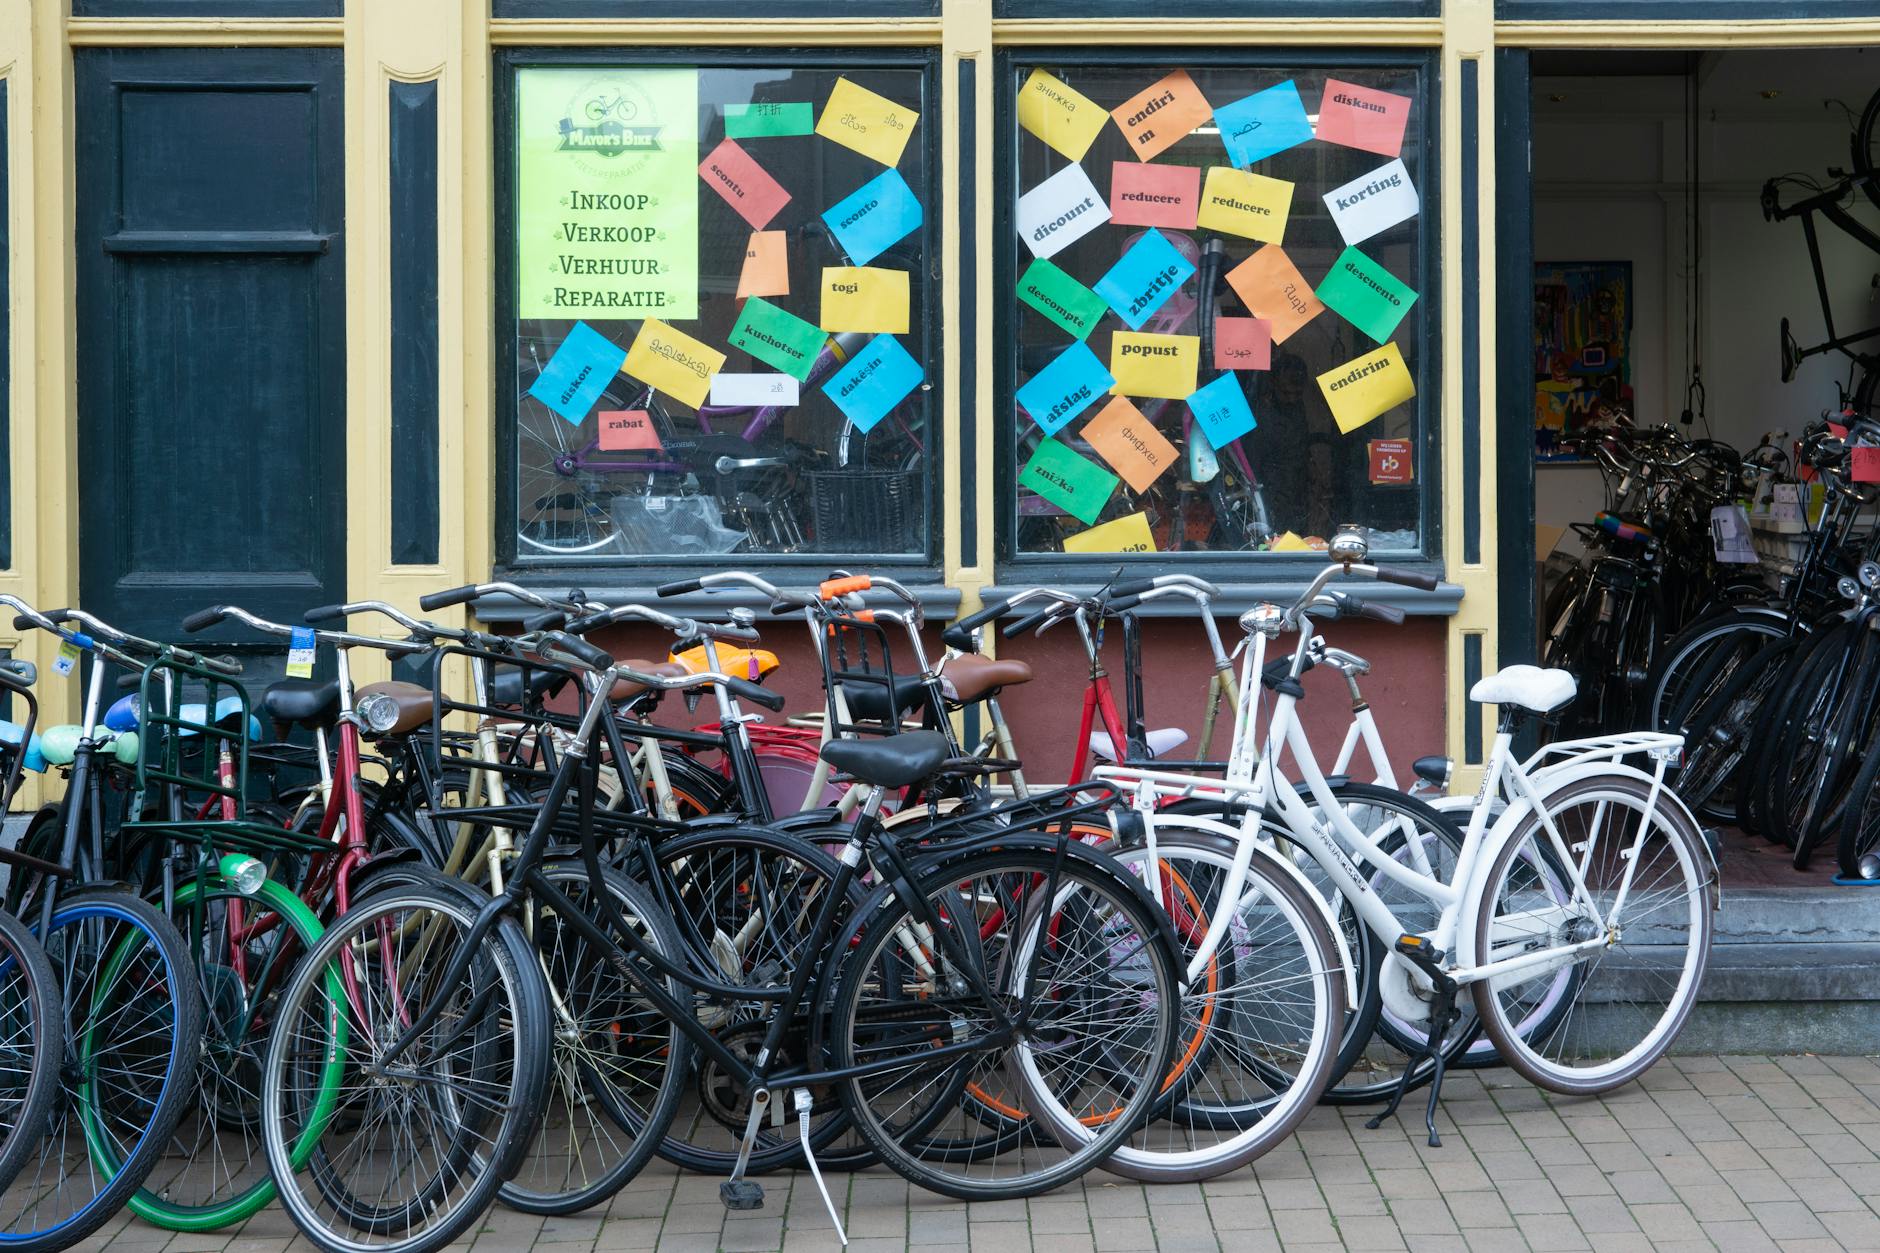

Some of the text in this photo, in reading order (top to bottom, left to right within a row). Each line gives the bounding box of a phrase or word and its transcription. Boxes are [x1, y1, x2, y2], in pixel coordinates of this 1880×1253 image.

[757, 104, 781, 116] 打折
[1035, 82, 1076, 112] знижка
[1126, 90, 1177, 128] endiri
[1333, 93, 1387, 115] diskaun
[1138, 129, 1156, 146] m
[1232, 117, 1262, 142] خصم
[710, 163, 745, 199] scontu
[1335, 172, 1402, 212] korting
[570, 191, 649, 210] INKOOP
[1121, 191, 1181, 204] reducere
[1212, 195, 1271, 217] reducere
[839, 198, 878, 230] sconto
[1033, 197, 1094, 242] dicount
[562, 223, 656, 243] VERKOOP
[559, 255, 659, 275] VERHUUR
[554, 288, 666, 307] REPARATIE
[831, 281, 858, 294] togi
[1129, 264, 1179, 318] zbritje
[1345, 261, 1402, 308] descuento
[1027, 284, 1085, 329] descompte
[738, 338, 746, 347] a
[744, 324, 806, 360] kuchotser
[1121, 343, 1179, 358] popust
[560, 364, 593, 406] diskon
[1329, 356, 1390, 393] endirim
[1045, 384, 1092, 425] afslag
[608, 418, 644, 429] rabat
[1122, 427, 1159, 466] тахфиф
